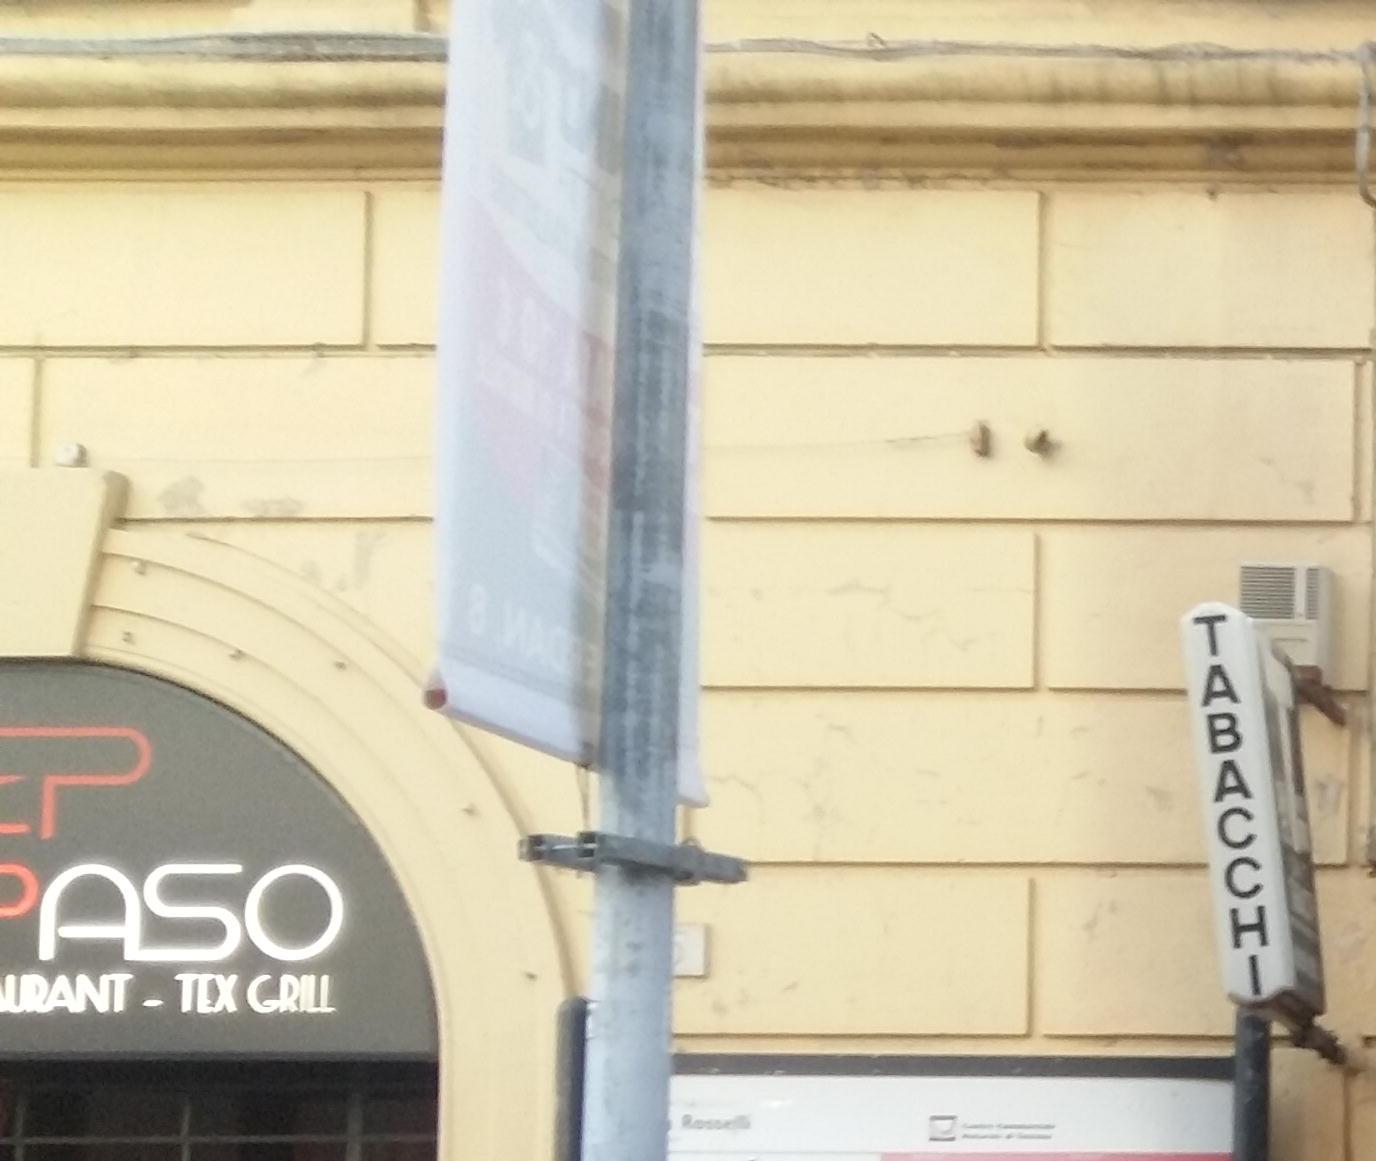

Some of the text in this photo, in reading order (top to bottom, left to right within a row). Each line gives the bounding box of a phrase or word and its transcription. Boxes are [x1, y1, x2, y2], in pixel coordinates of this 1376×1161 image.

[1192, 614, 1270, 996] TABACCHI
[0, 972, 134, 1014] URANT
[175, 973, 239, 1014] TEX
[247, 973, 337, 1014] GRILL
